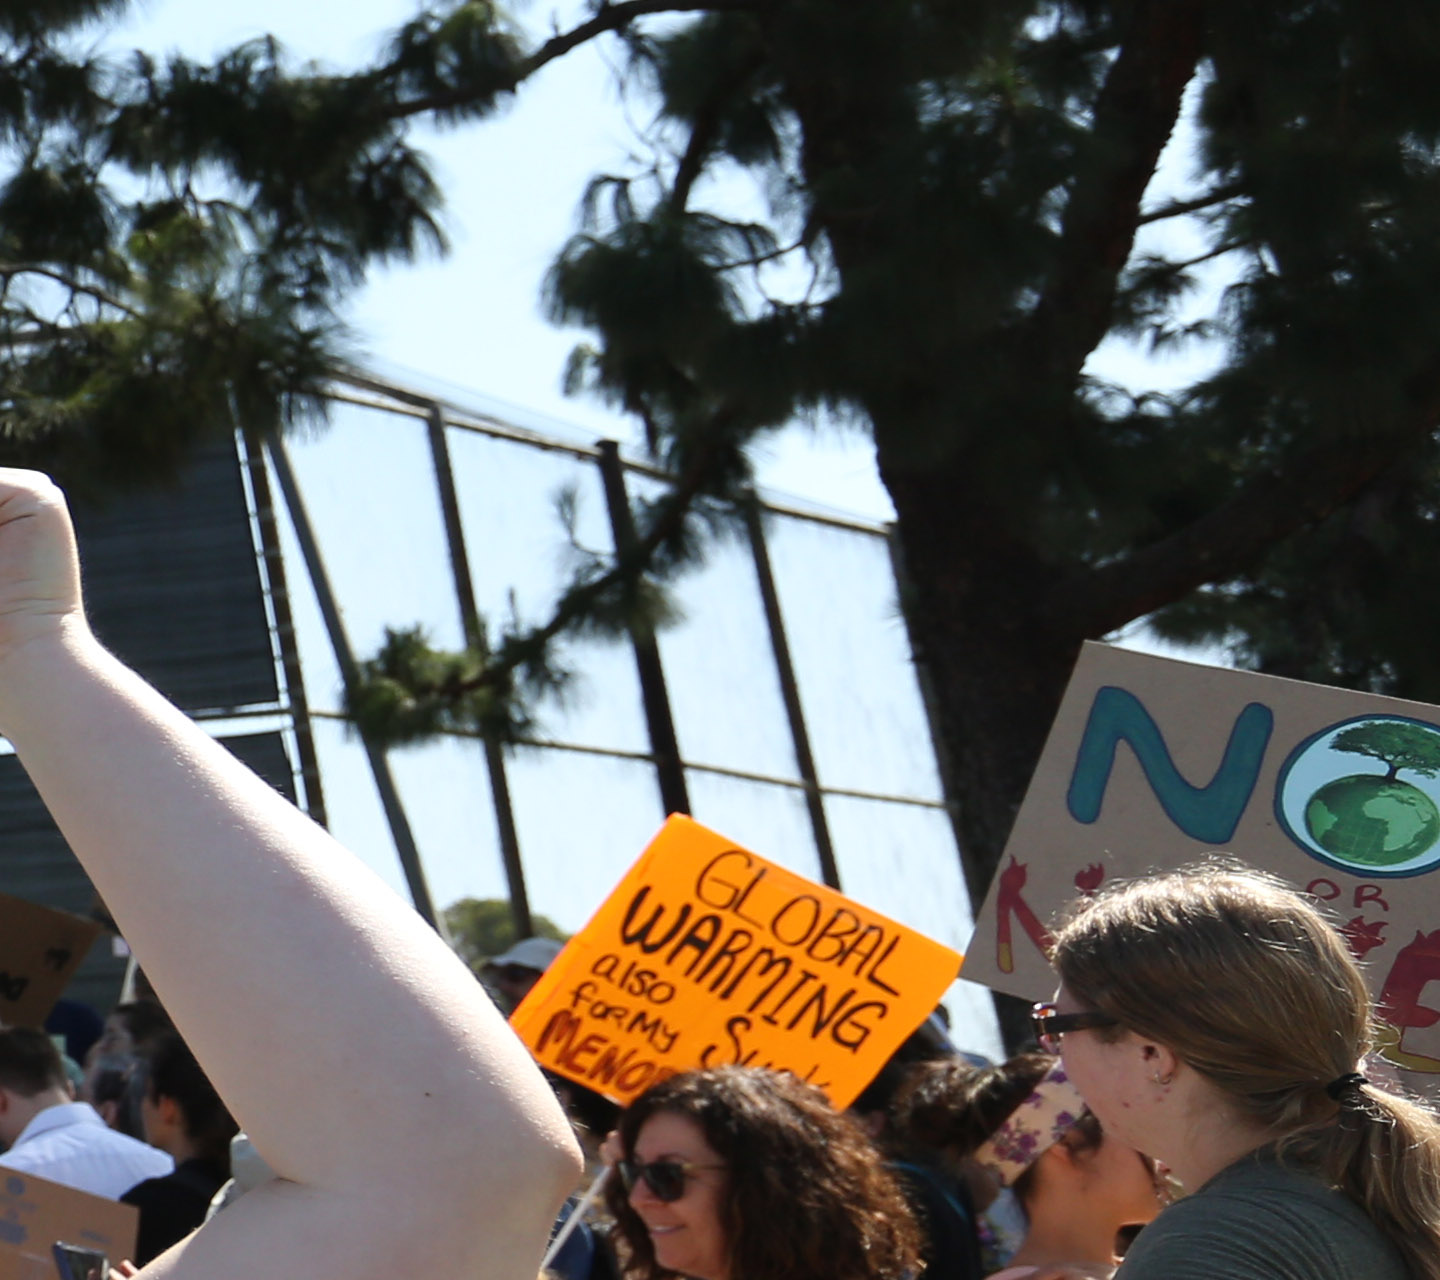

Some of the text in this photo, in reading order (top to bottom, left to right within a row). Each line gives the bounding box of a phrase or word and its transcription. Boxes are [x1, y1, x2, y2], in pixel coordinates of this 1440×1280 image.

[1306, 878, 1389, 911] OR
[696, 849, 901, 997] GLOBAL
[591, 953, 677, 1005] also
[620, 885, 888, 1054] WARMING
[631, 1012, 680, 1053] MY
